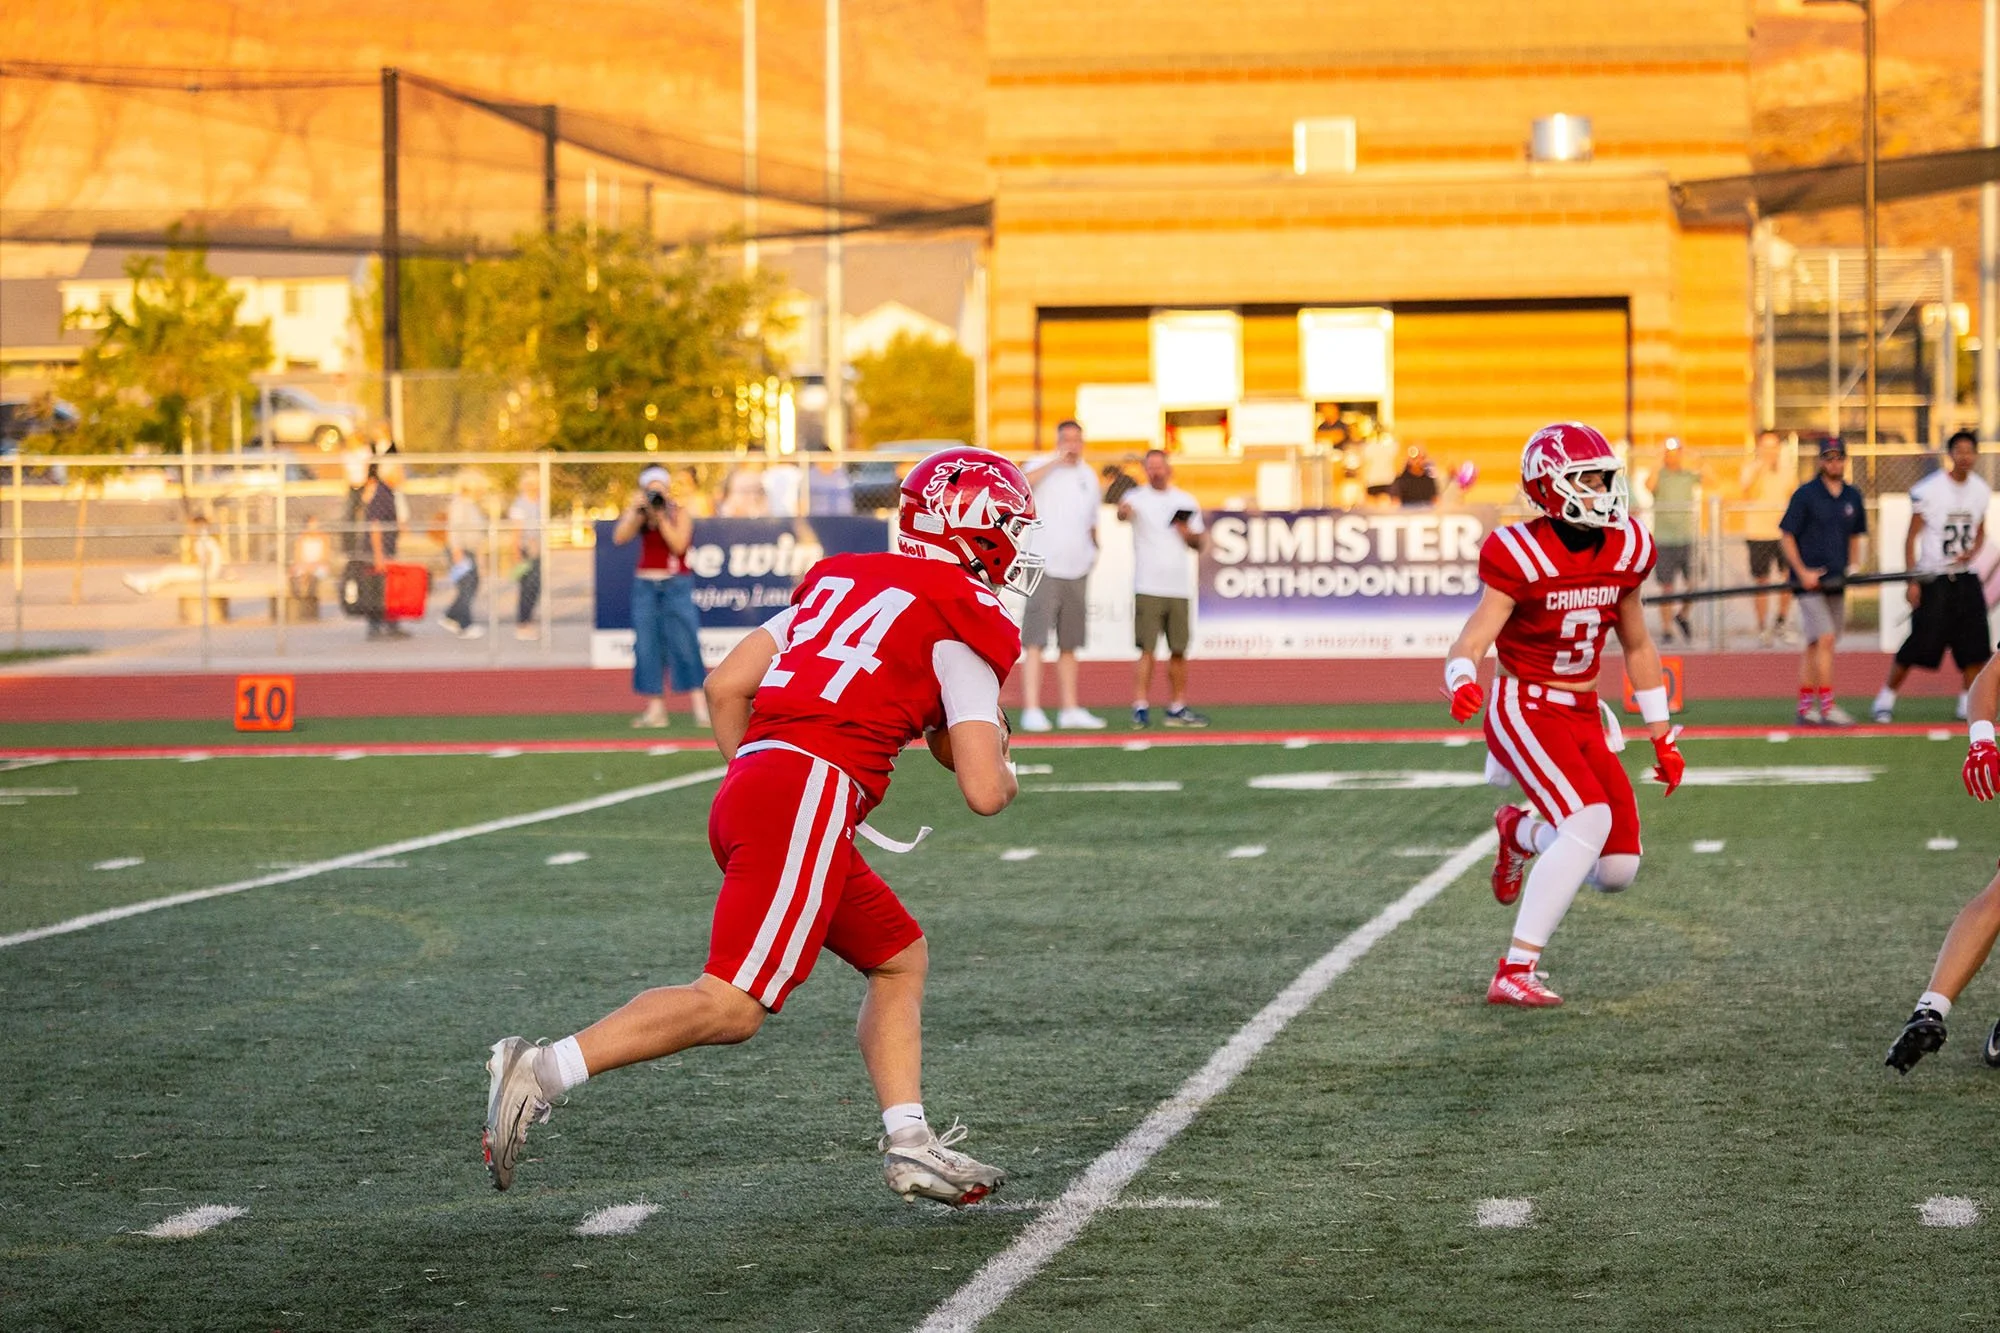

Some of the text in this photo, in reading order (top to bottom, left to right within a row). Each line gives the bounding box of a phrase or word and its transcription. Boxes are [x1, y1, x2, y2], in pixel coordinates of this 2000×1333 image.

[1211, 515, 1483, 564] SIMISTER
[1214, 564, 1480, 598] ORTHODONTICS
[1546, 585, 1620, 610] CRIMSON
[760, 576, 916, 703] 24
[1552, 608, 1601, 675] 3
[242, 686, 286, 721] 10
